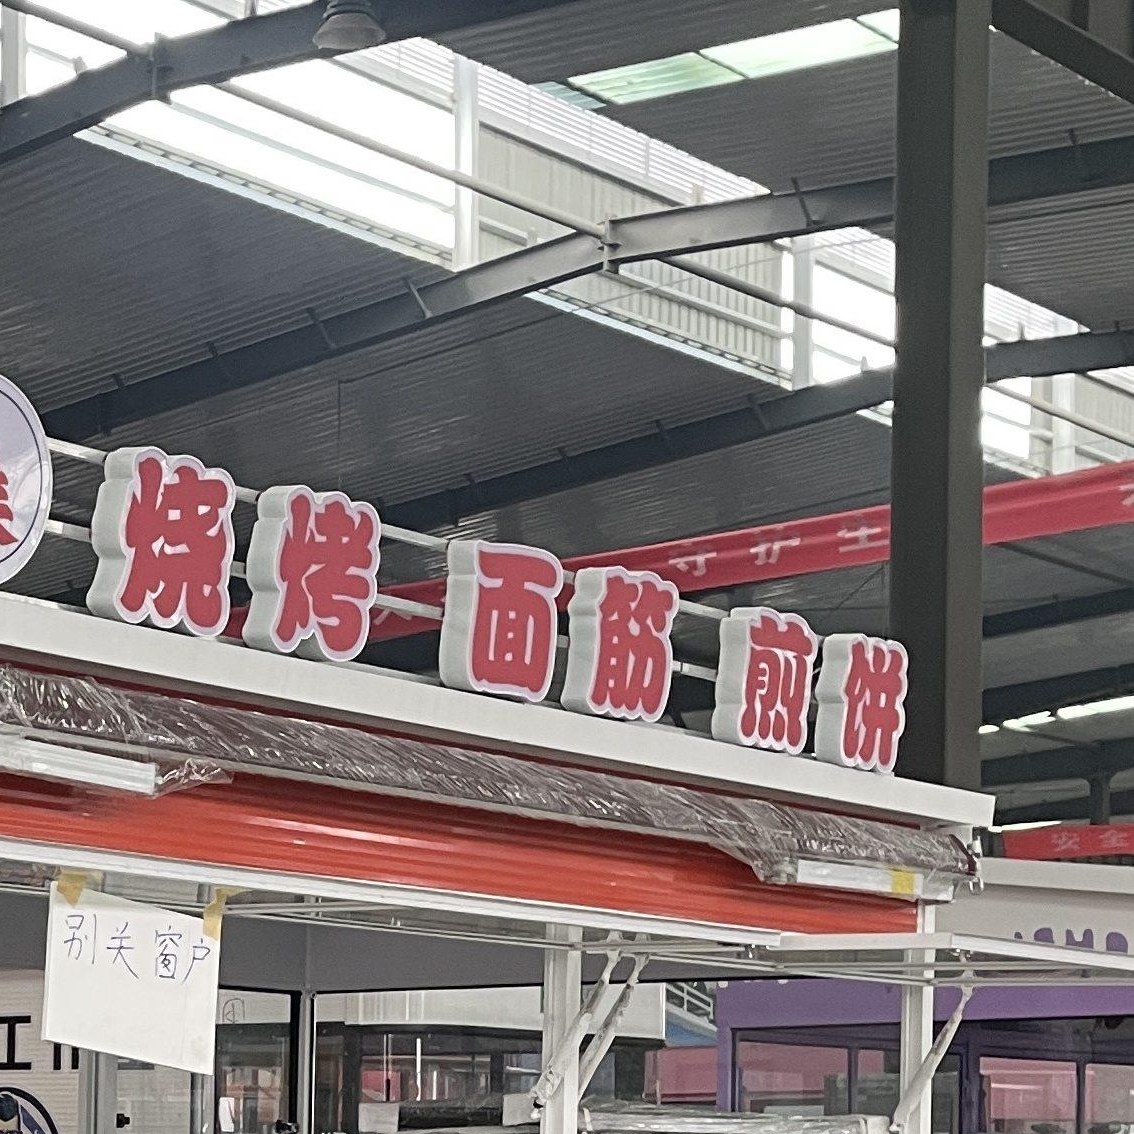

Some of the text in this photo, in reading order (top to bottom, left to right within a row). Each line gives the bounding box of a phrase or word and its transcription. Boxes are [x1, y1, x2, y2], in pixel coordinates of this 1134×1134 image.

[117, 454, 905, 769] 烧烤 面筋 煎饼
[63, 912, 212, 983] 别关窗户
